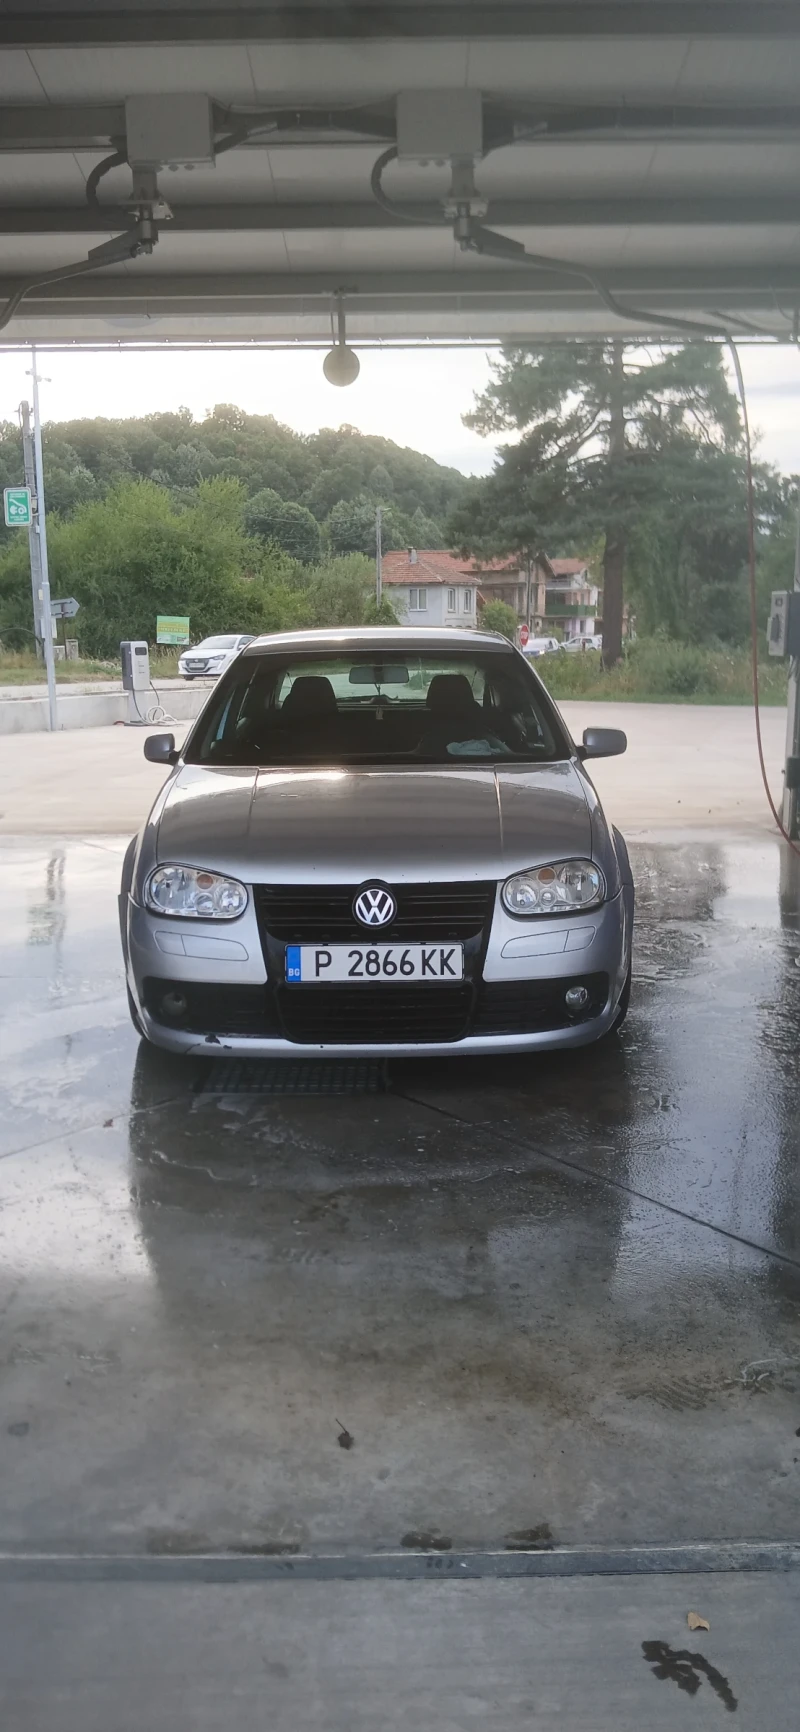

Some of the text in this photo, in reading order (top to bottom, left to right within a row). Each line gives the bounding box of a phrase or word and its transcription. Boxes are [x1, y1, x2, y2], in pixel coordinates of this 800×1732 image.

[315, 948, 457, 977] P 2866 KK
[288, 968, 300, 977] BG
